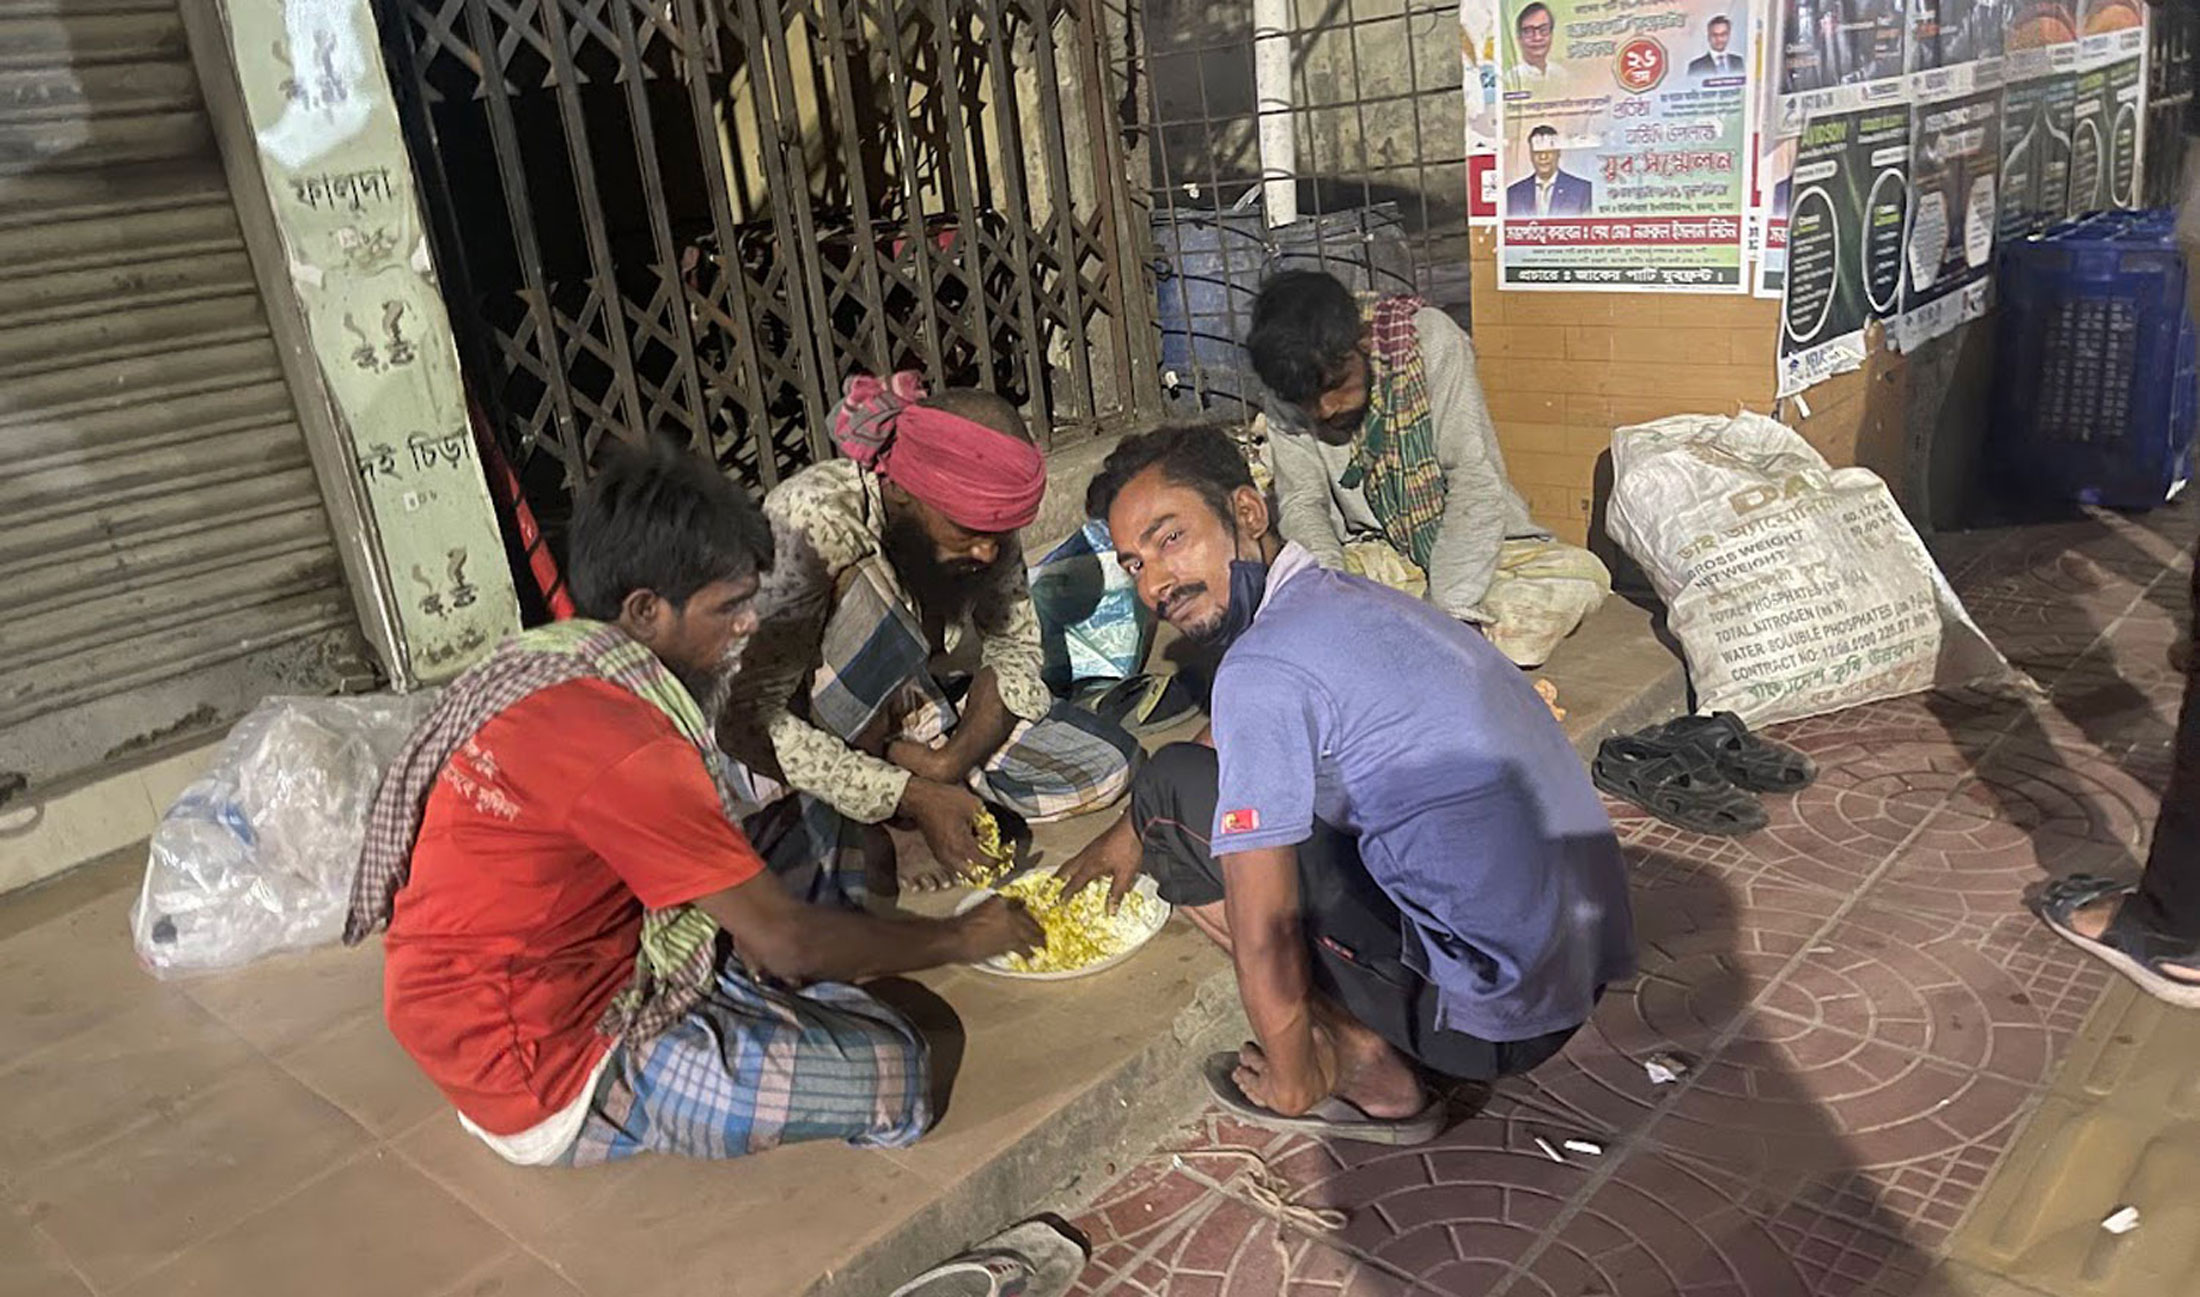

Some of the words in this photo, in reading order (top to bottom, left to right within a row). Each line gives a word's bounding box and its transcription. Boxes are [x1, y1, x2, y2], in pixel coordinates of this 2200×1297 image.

[1738, 529, 1804, 557] WEIGHT
[1694, 571, 1720, 590] NET
[1720, 549, 1786, 579] WEIGHT
[1709, 602, 1746, 624] TOTAL
[1715, 623, 1754, 644] TOTAL
[1753, 607, 1815, 635] NITROGEN
[1720, 642, 1766, 665] WATER
[1766, 626, 1822, 653] SOLUBLE
[1822, 602, 1894, 640] PHOSPHATES
[1731, 653, 1798, 682] CONTRACT
